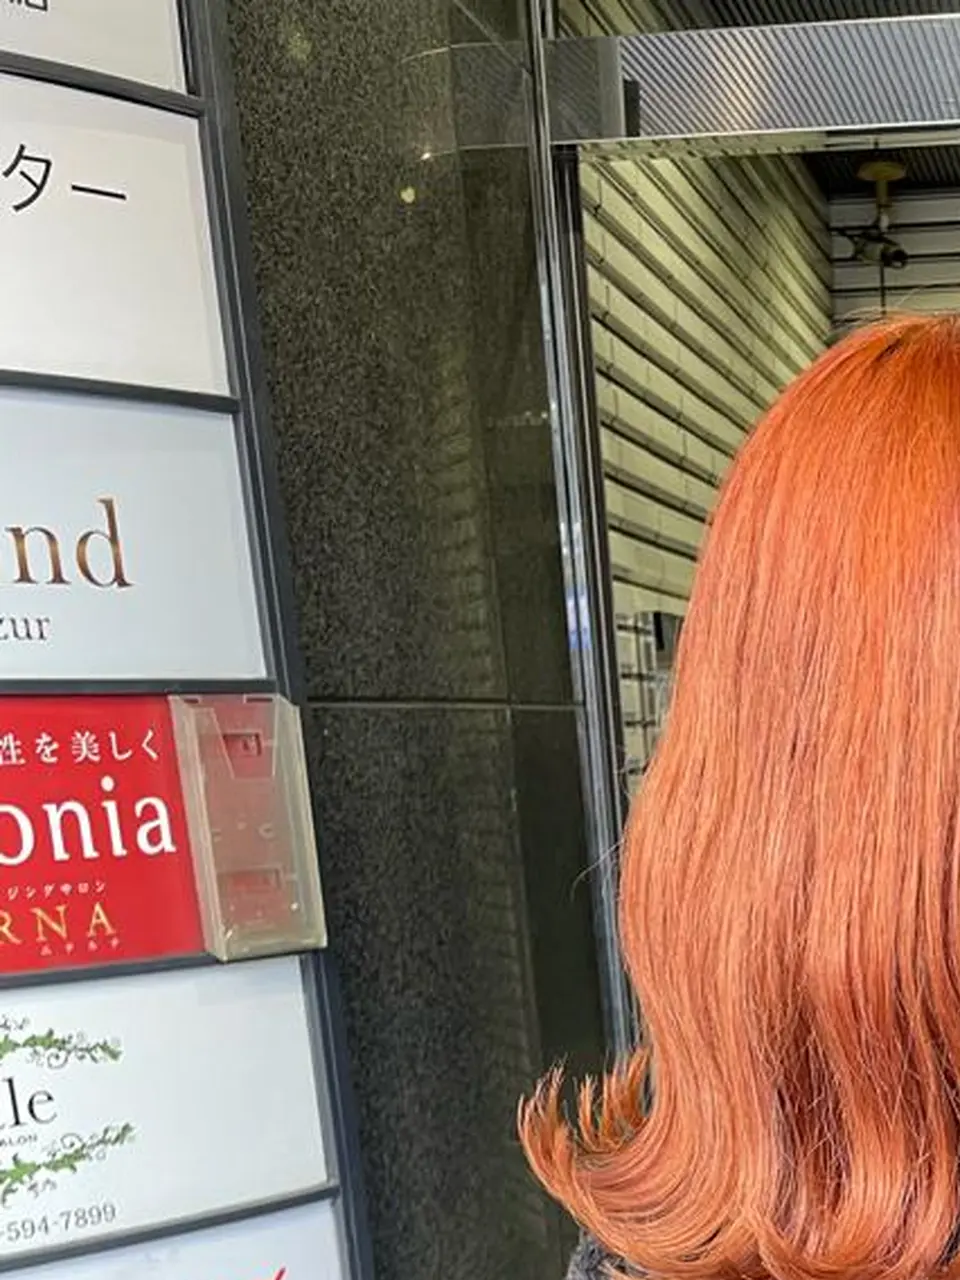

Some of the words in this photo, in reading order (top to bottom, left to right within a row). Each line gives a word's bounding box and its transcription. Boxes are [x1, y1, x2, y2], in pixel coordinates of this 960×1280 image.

[2, 144, 127, 211] ター
[4, 497, 135, 588] nd
[0, 729, 160, 765] 性を美しく
[0, 775, 177, 866] onia
[0, 1077, 58, 1128] le
